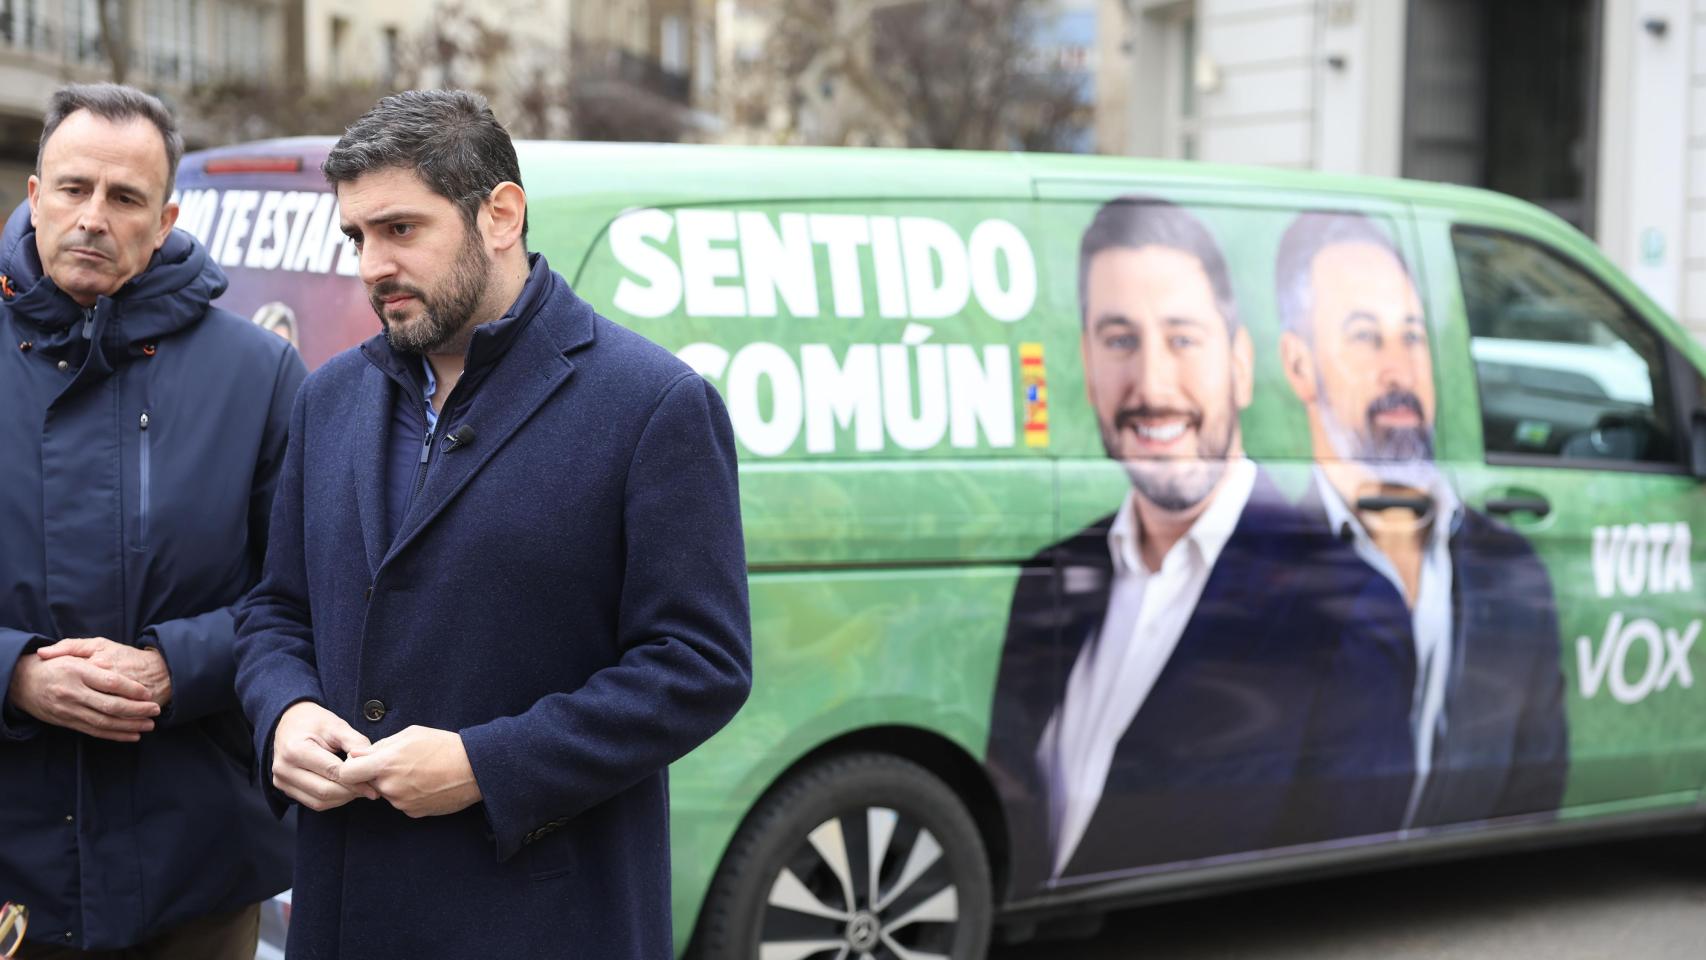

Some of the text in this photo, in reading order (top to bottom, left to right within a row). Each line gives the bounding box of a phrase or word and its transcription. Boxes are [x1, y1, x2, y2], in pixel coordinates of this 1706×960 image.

[209, 190, 261, 267] TE
[608, 207, 1038, 322] SENTIDO
[1592, 522, 1693, 598] VOTA
